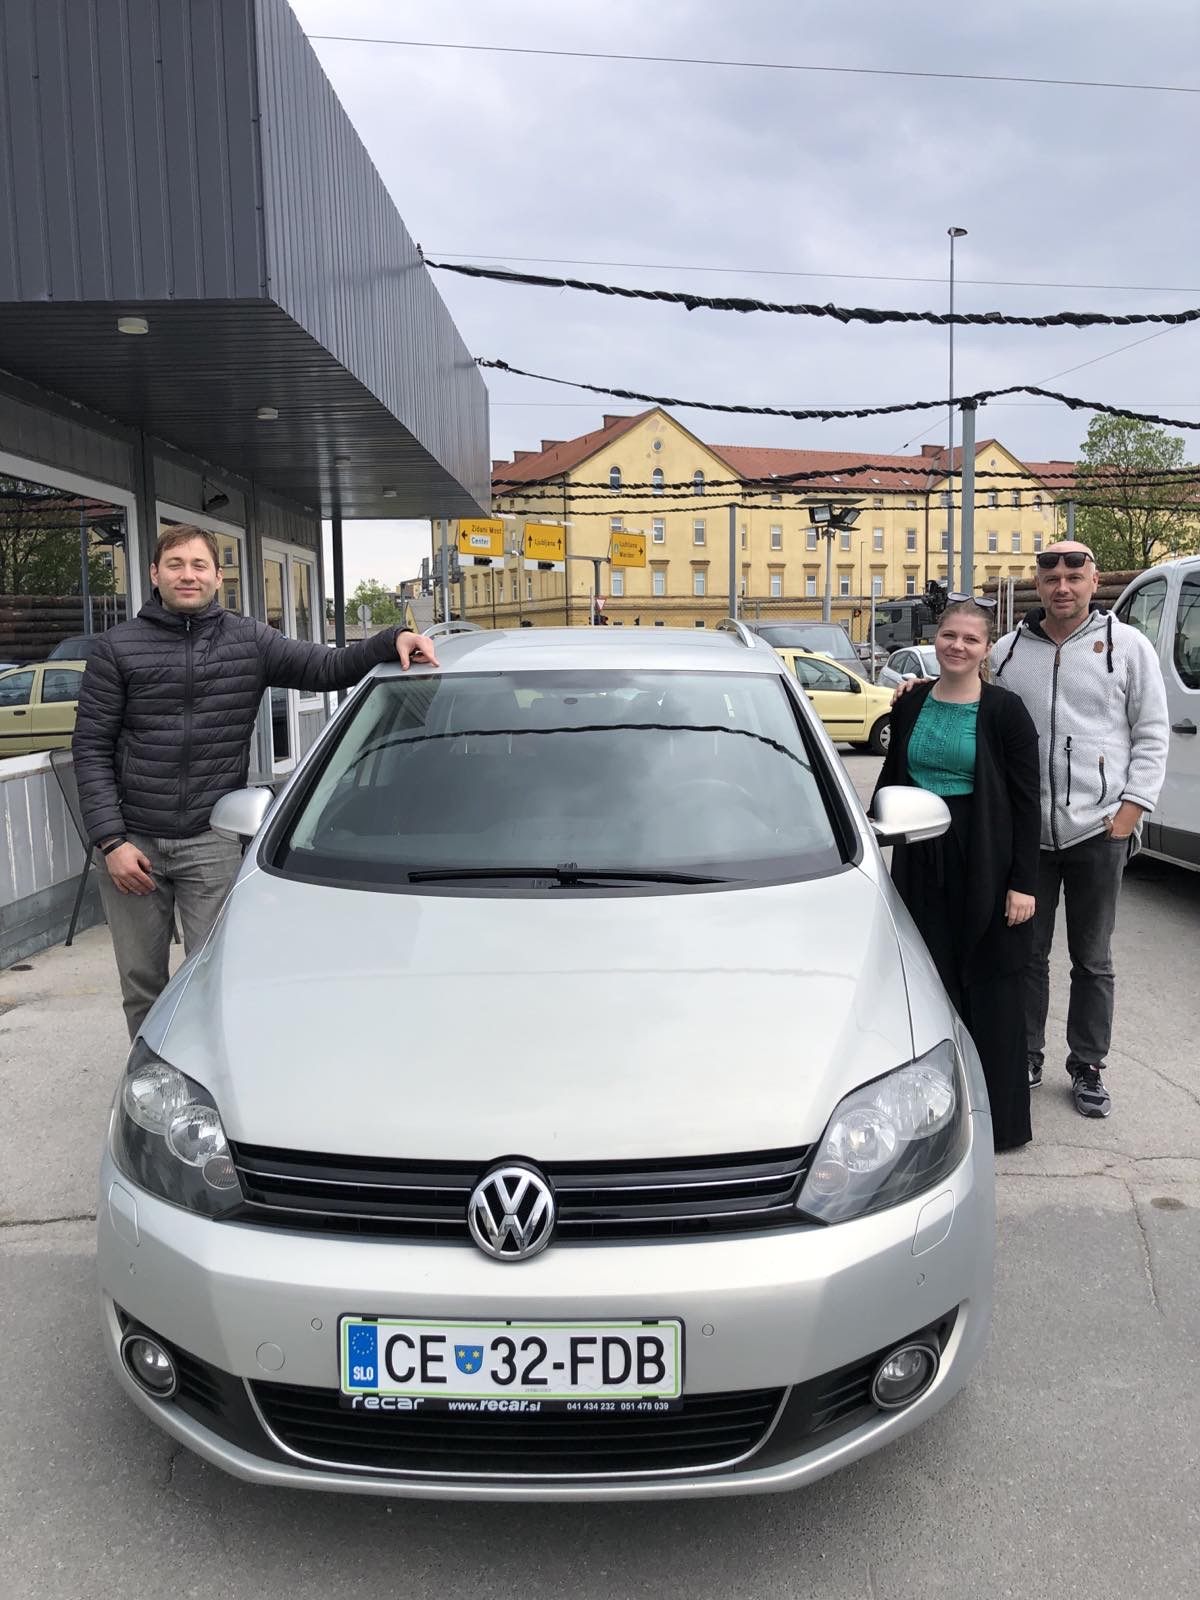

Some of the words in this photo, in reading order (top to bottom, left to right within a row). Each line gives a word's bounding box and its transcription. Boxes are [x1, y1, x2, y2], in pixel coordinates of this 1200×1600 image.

[472, 537, 489, 545] Center
[385, 1333, 447, 1383] CE
[491, 1336, 666, 1386] 32-FDB
[353, 1366, 374, 1381] SLO
[352, 1396, 425, 1410] recar
[448, 1400, 541, 1412] www.recar.si
[567, 1402, 581, 1411] 041
[583, 1402, 598, 1411] 434
[600, 1402, 615, 1411] 232
[620, 1402, 635, 1411] 051
[654, 1402, 669, 1411] 039
